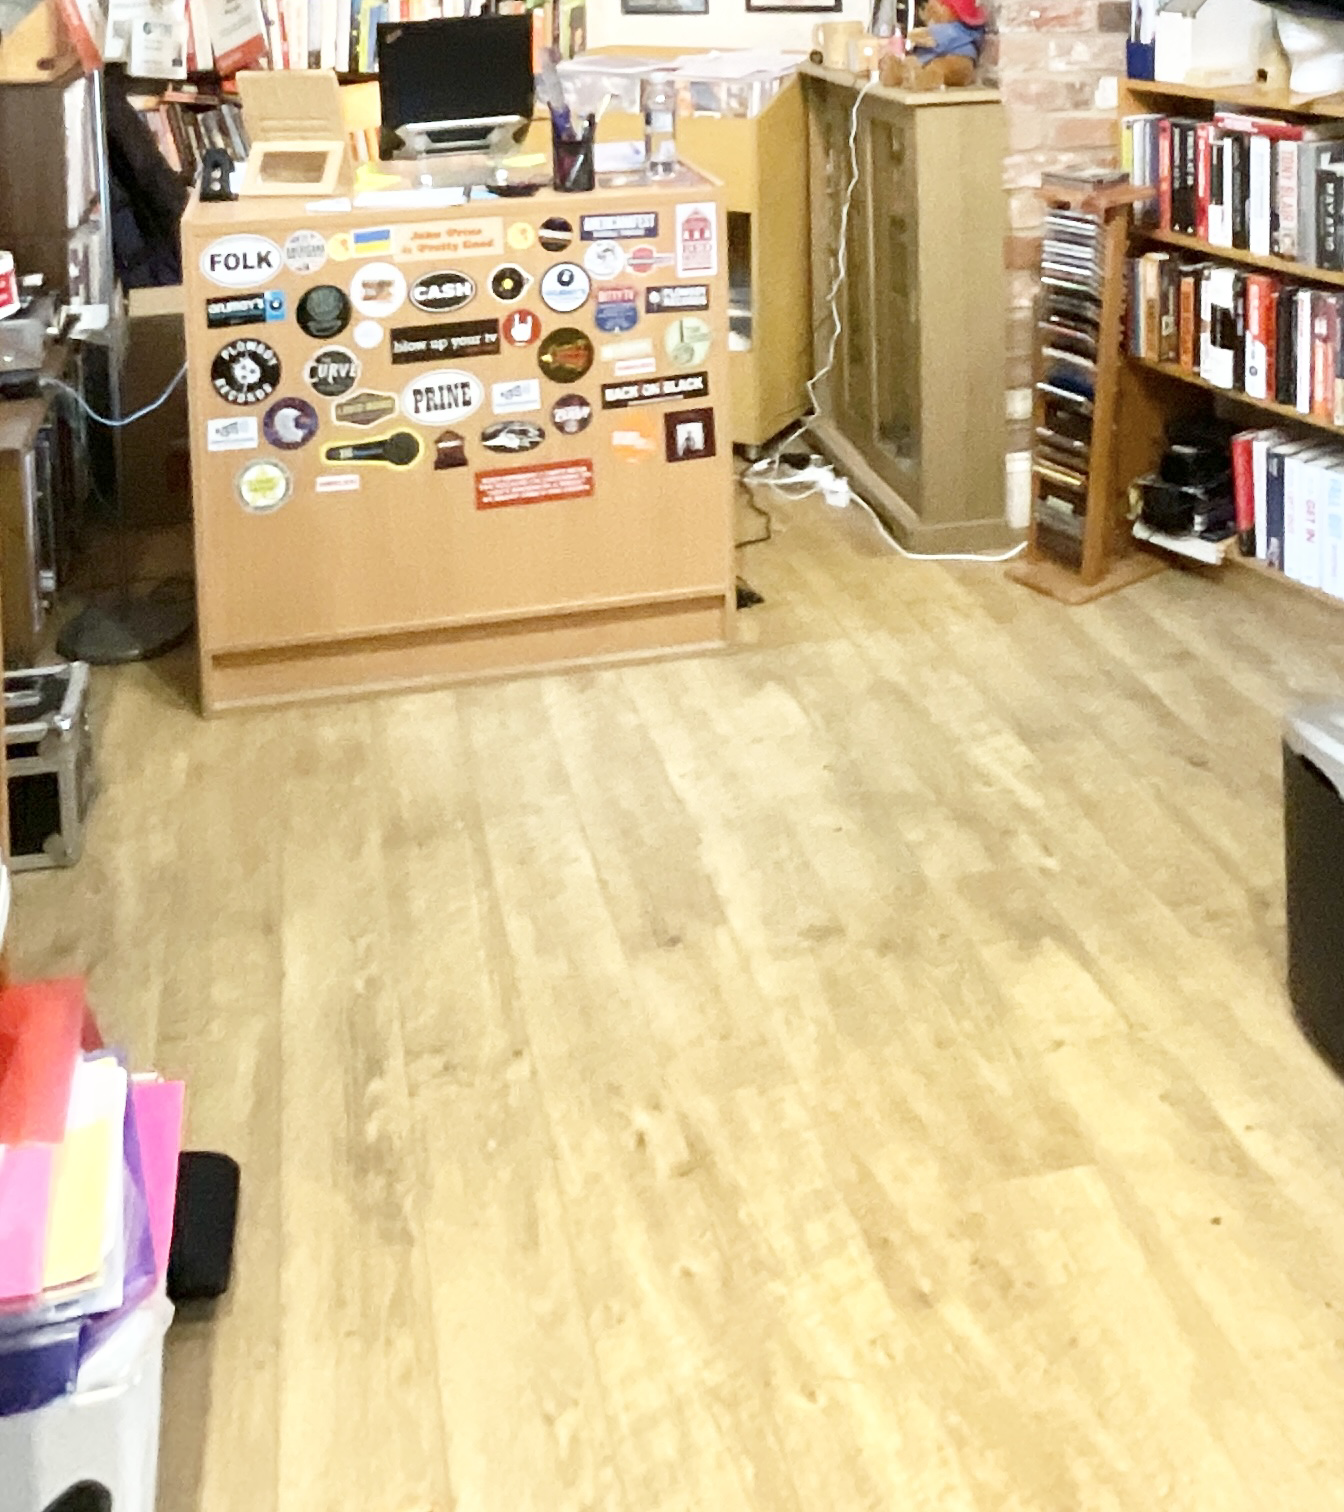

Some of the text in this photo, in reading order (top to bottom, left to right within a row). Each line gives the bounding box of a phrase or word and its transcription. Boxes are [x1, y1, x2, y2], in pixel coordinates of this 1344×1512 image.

[210, 250, 274, 272] FOLK
[414, 282, 473, 301] CASH
[220, 340, 278, 366] PLOWBOY
[393, 339, 428, 354] blow
[429, 340, 449, 352] up
[450, 335, 482, 350] your
[214, 377, 273, 404] RECORDS
[412, 380, 472, 414] PRINE
